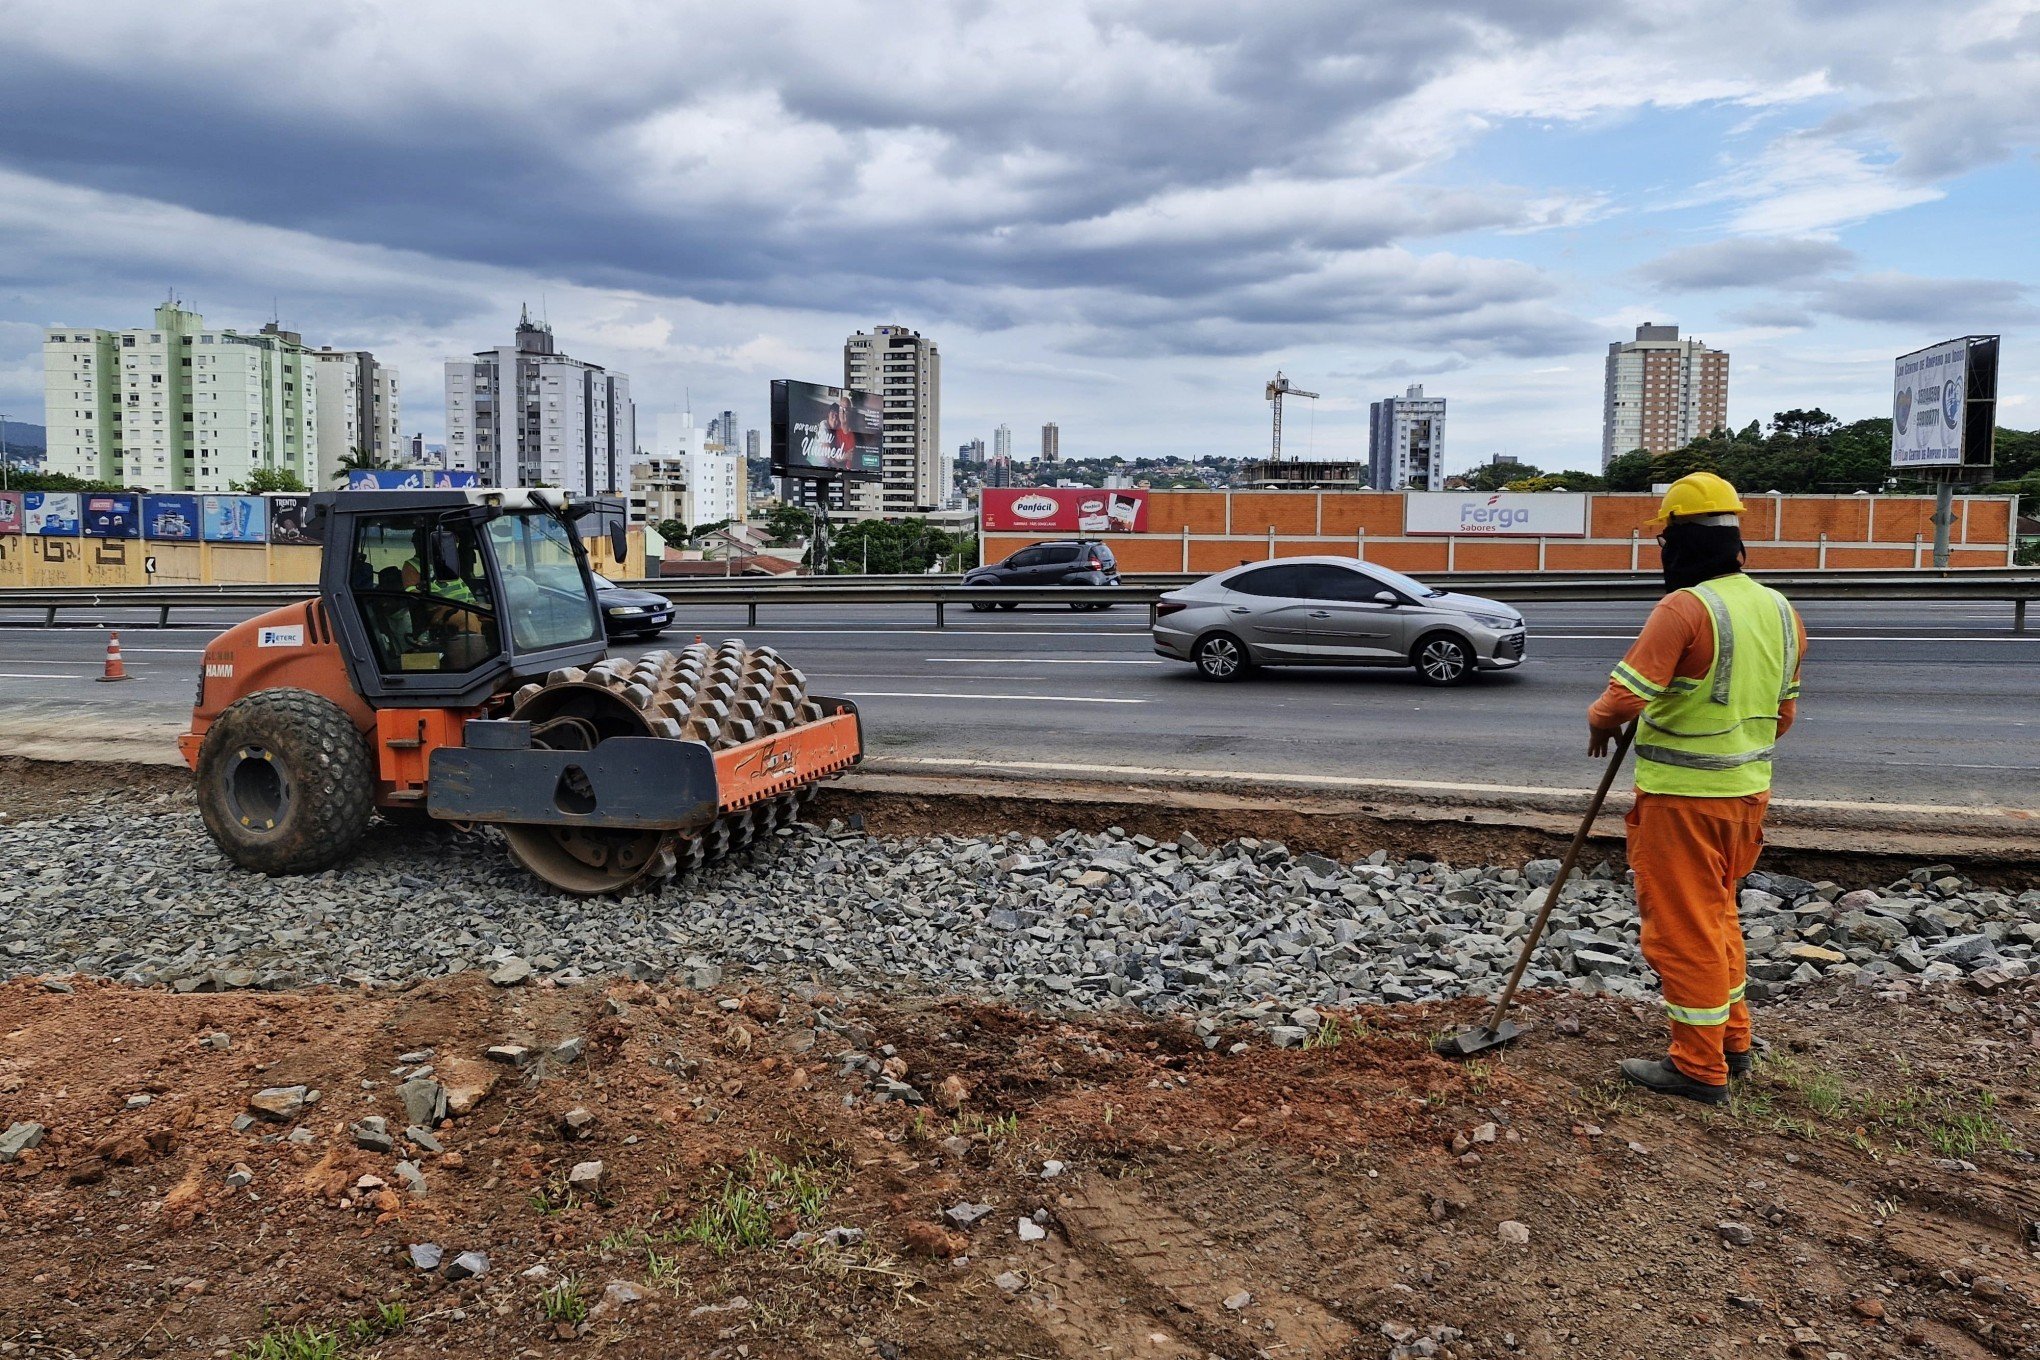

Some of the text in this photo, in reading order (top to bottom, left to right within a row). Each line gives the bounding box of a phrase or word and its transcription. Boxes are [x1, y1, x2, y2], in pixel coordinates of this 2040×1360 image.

[275, 499, 297, 507] TRENTO
[1017, 503, 1052, 513] Panfácil
[1461, 503, 1529, 528] Ferga
[206, 664, 233, 678] HAMM
